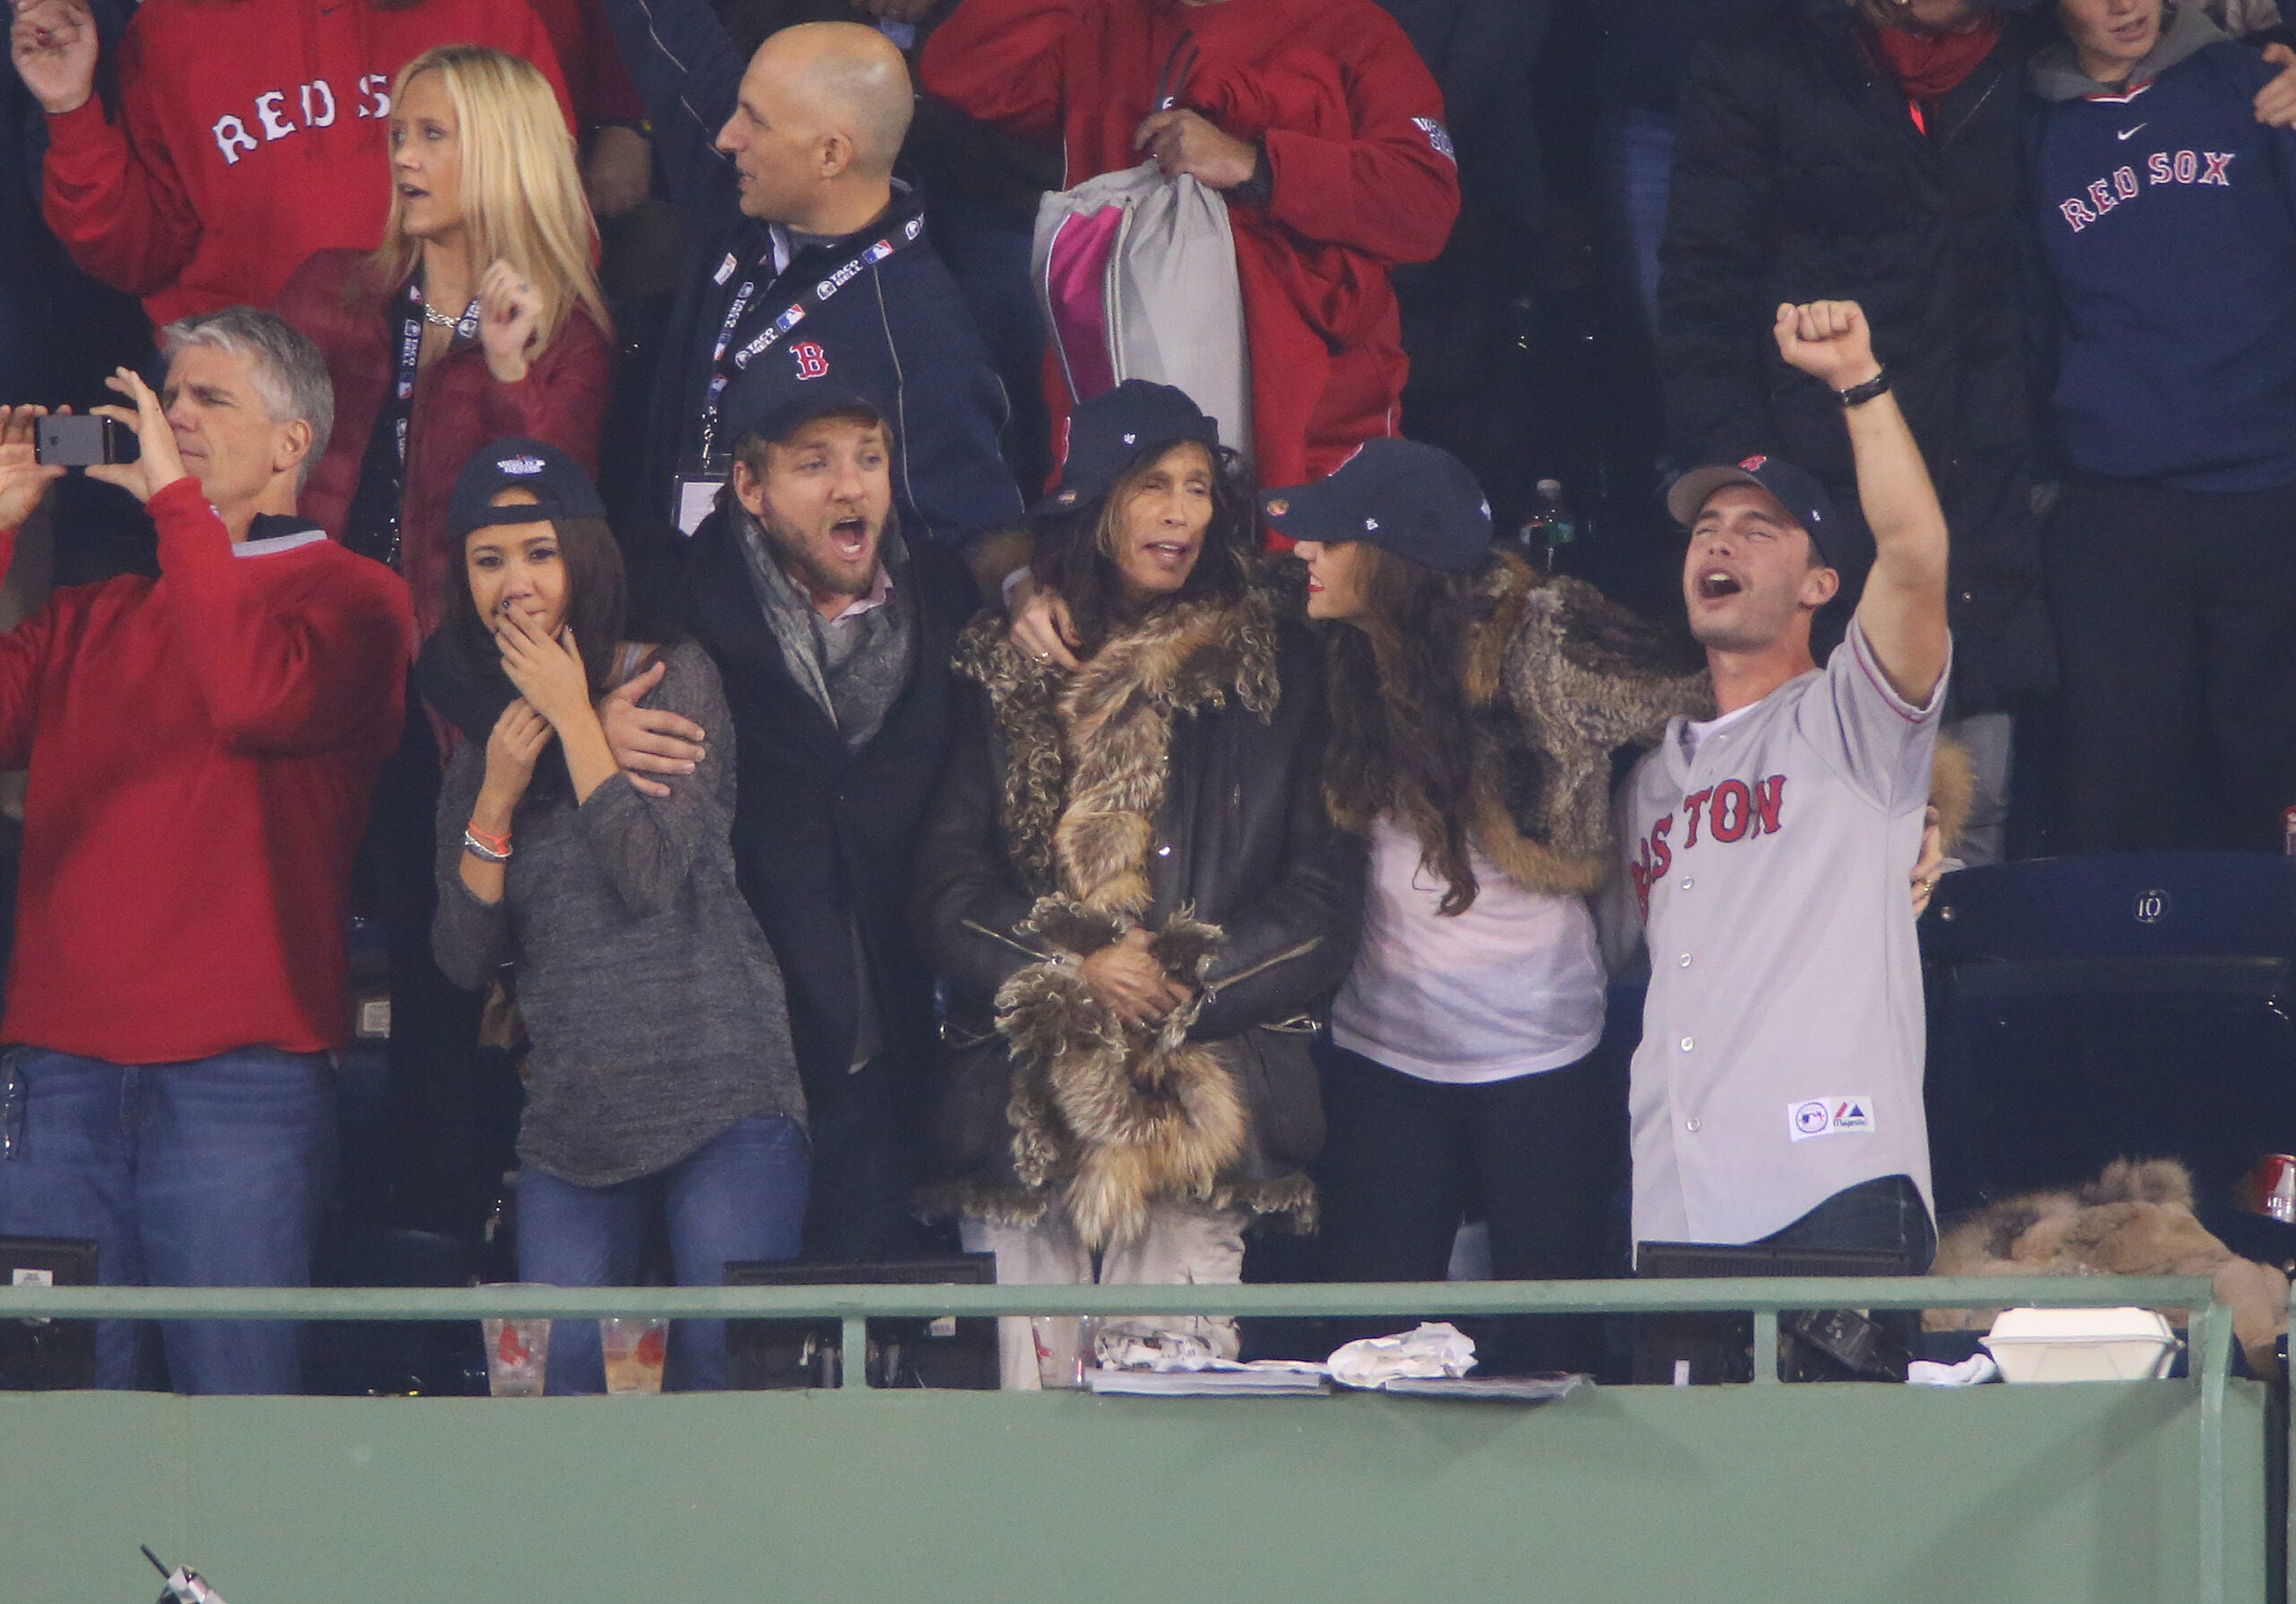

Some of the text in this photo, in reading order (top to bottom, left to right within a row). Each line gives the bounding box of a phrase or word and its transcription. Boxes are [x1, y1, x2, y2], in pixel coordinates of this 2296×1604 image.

[212, 78, 337, 166] RED
[2058, 149, 2237, 233] RED SOX
[828, 259, 859, 282] TACO
[746, 327, 774, 351] TACO
[789, 341, 830, 380] B
[1631, 774, 1787, 928] STON
[2138, 897, 2161, 917] 10
